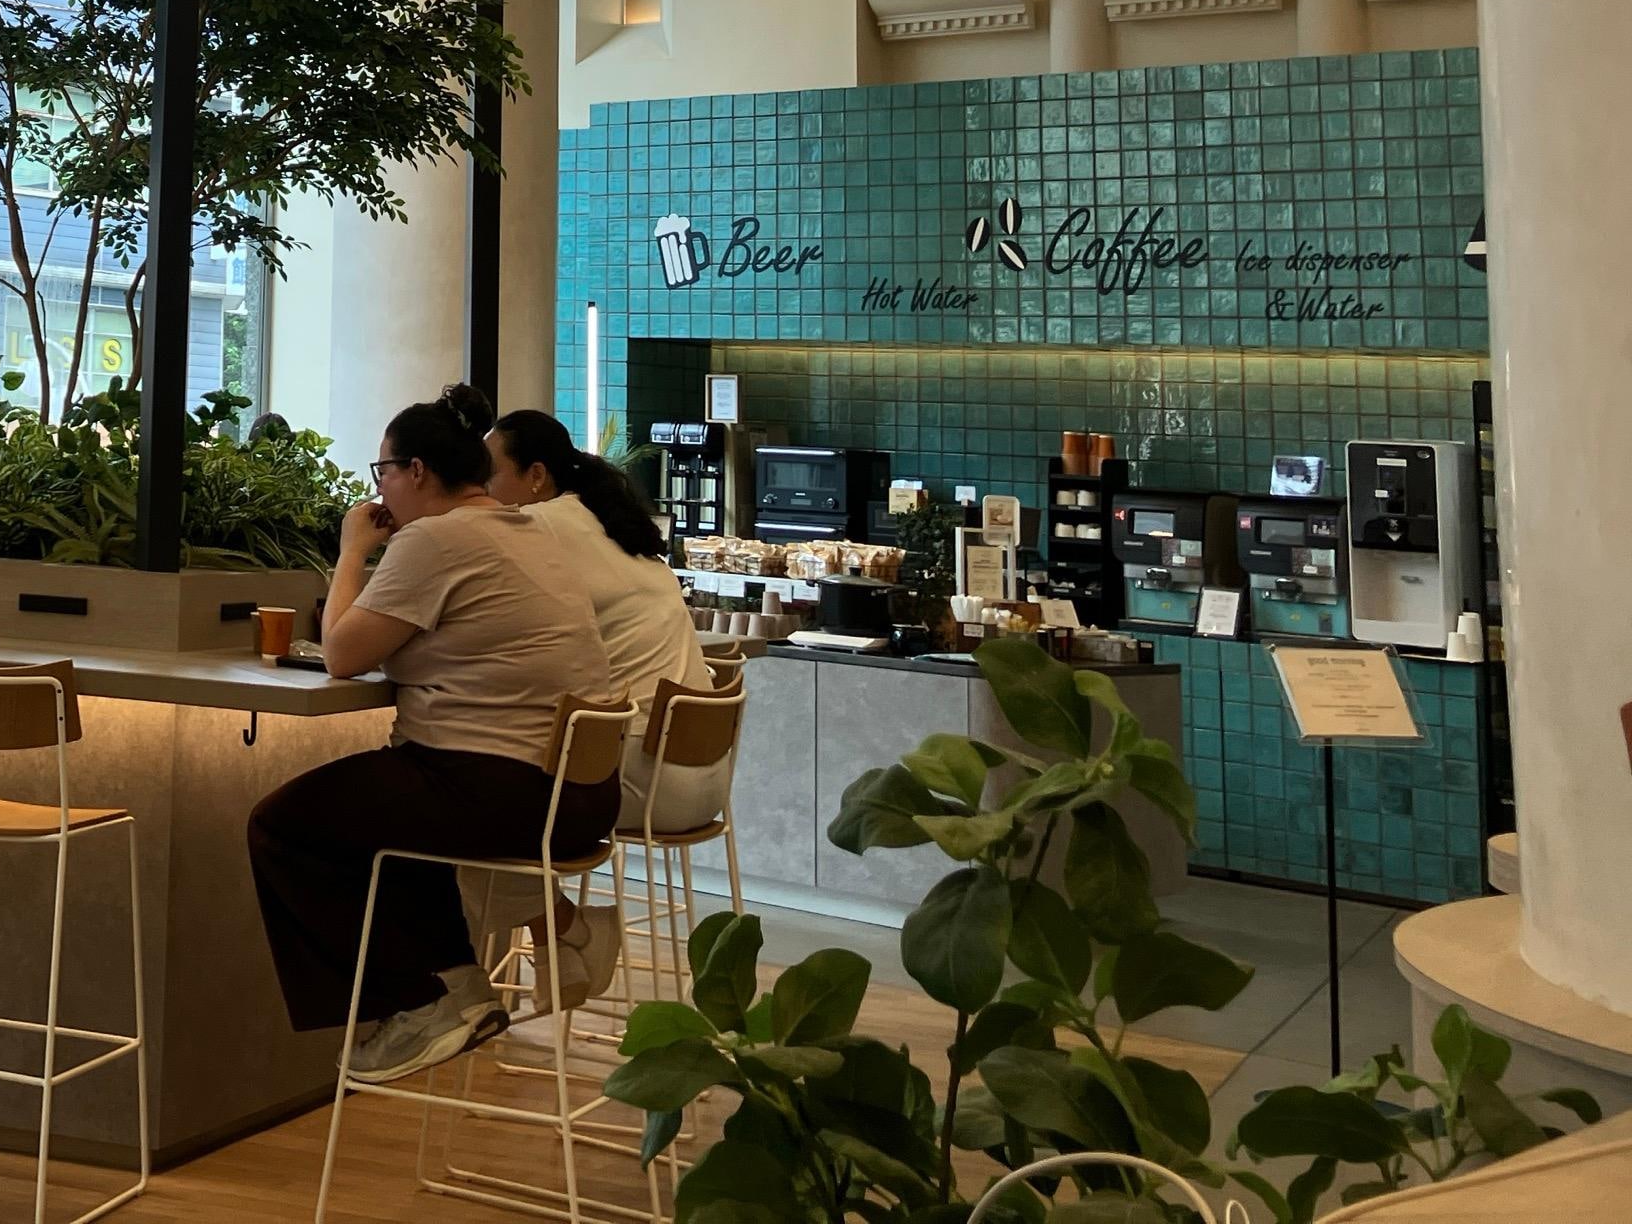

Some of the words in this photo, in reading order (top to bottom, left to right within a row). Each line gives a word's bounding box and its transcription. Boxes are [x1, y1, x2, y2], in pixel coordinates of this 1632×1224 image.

[718, 216, 824, 278] Beer
[1044, 206, 1210, 296] Coffee
[1234, 239, 1271, 274] Ice
[1285, 240, 1413, 285] dispenser
[860, 276, 904, 312] Hot
[910, 277, 980, 313] Water
